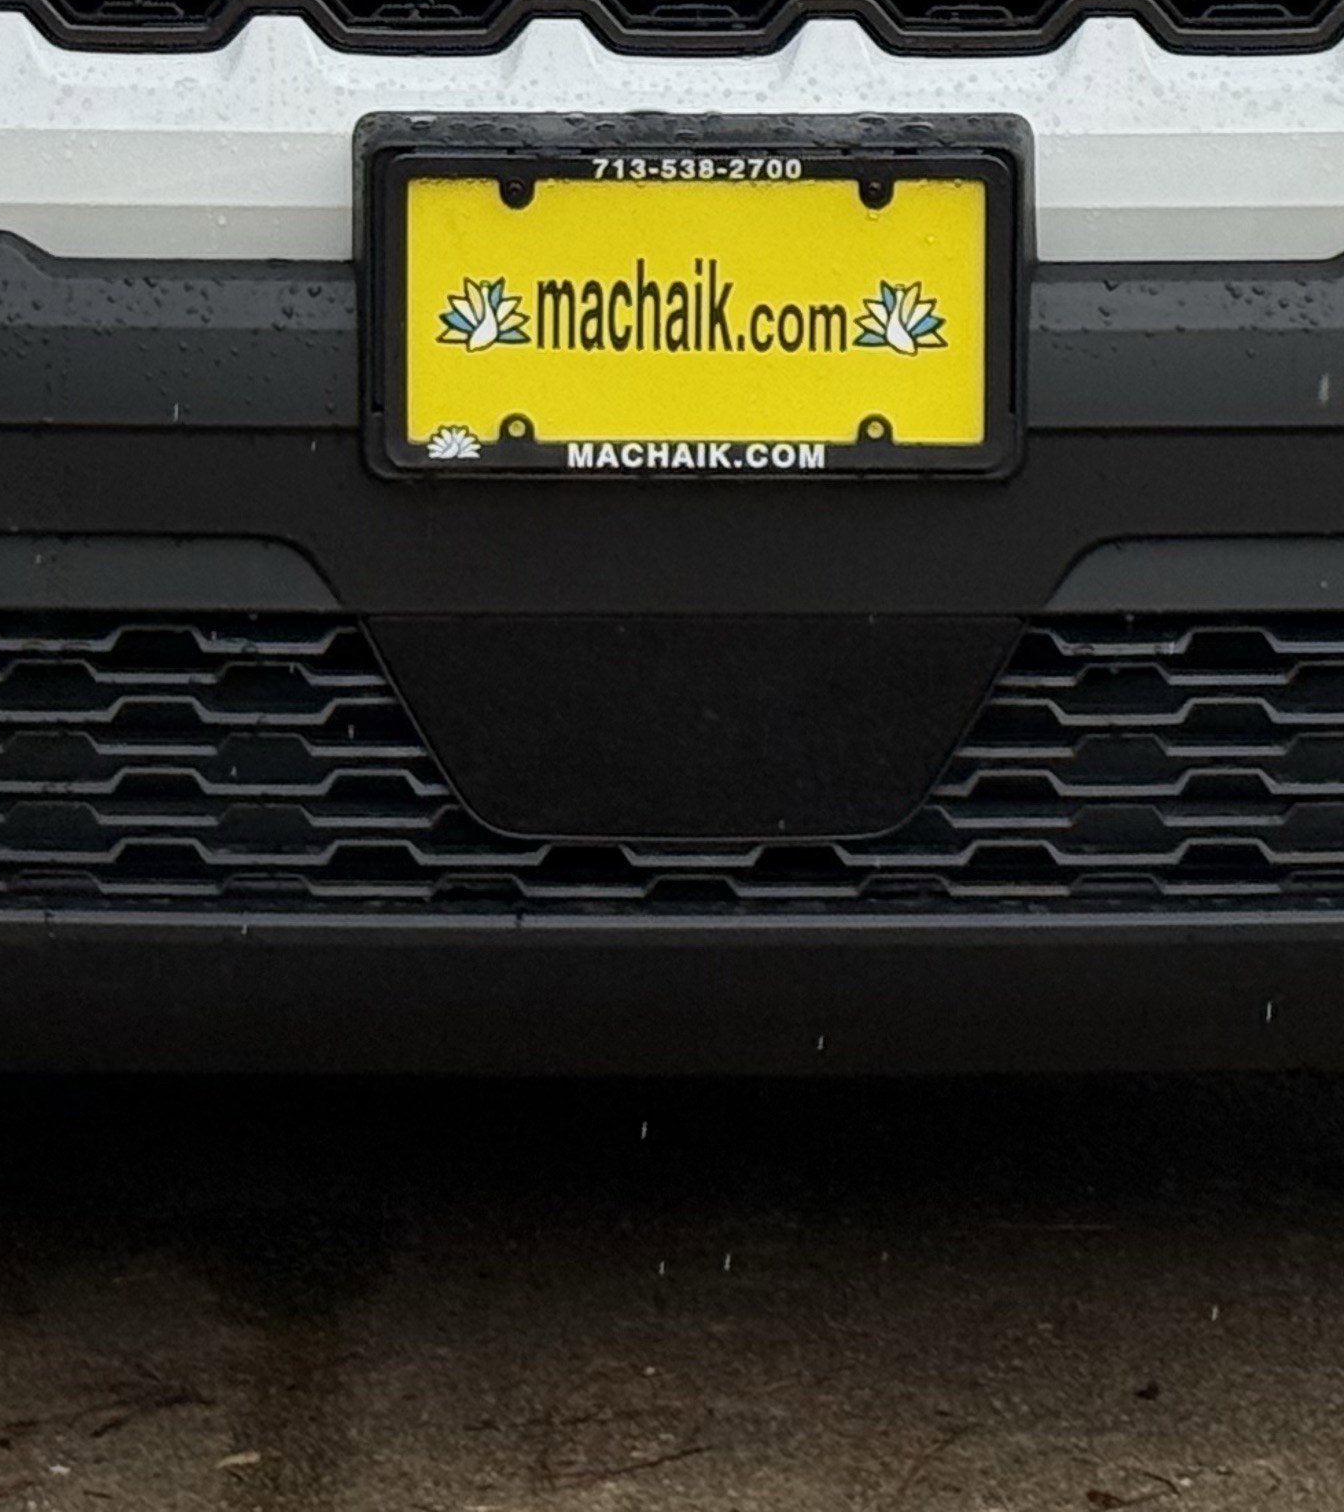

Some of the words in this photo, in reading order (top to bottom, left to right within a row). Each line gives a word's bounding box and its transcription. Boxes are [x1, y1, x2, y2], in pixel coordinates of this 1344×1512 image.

[592, 158, 803, 180] 713-538-2700
[536, 258, 847, 352] machaik.com
[567, 442, 826, 469] MACHAIK.COM
